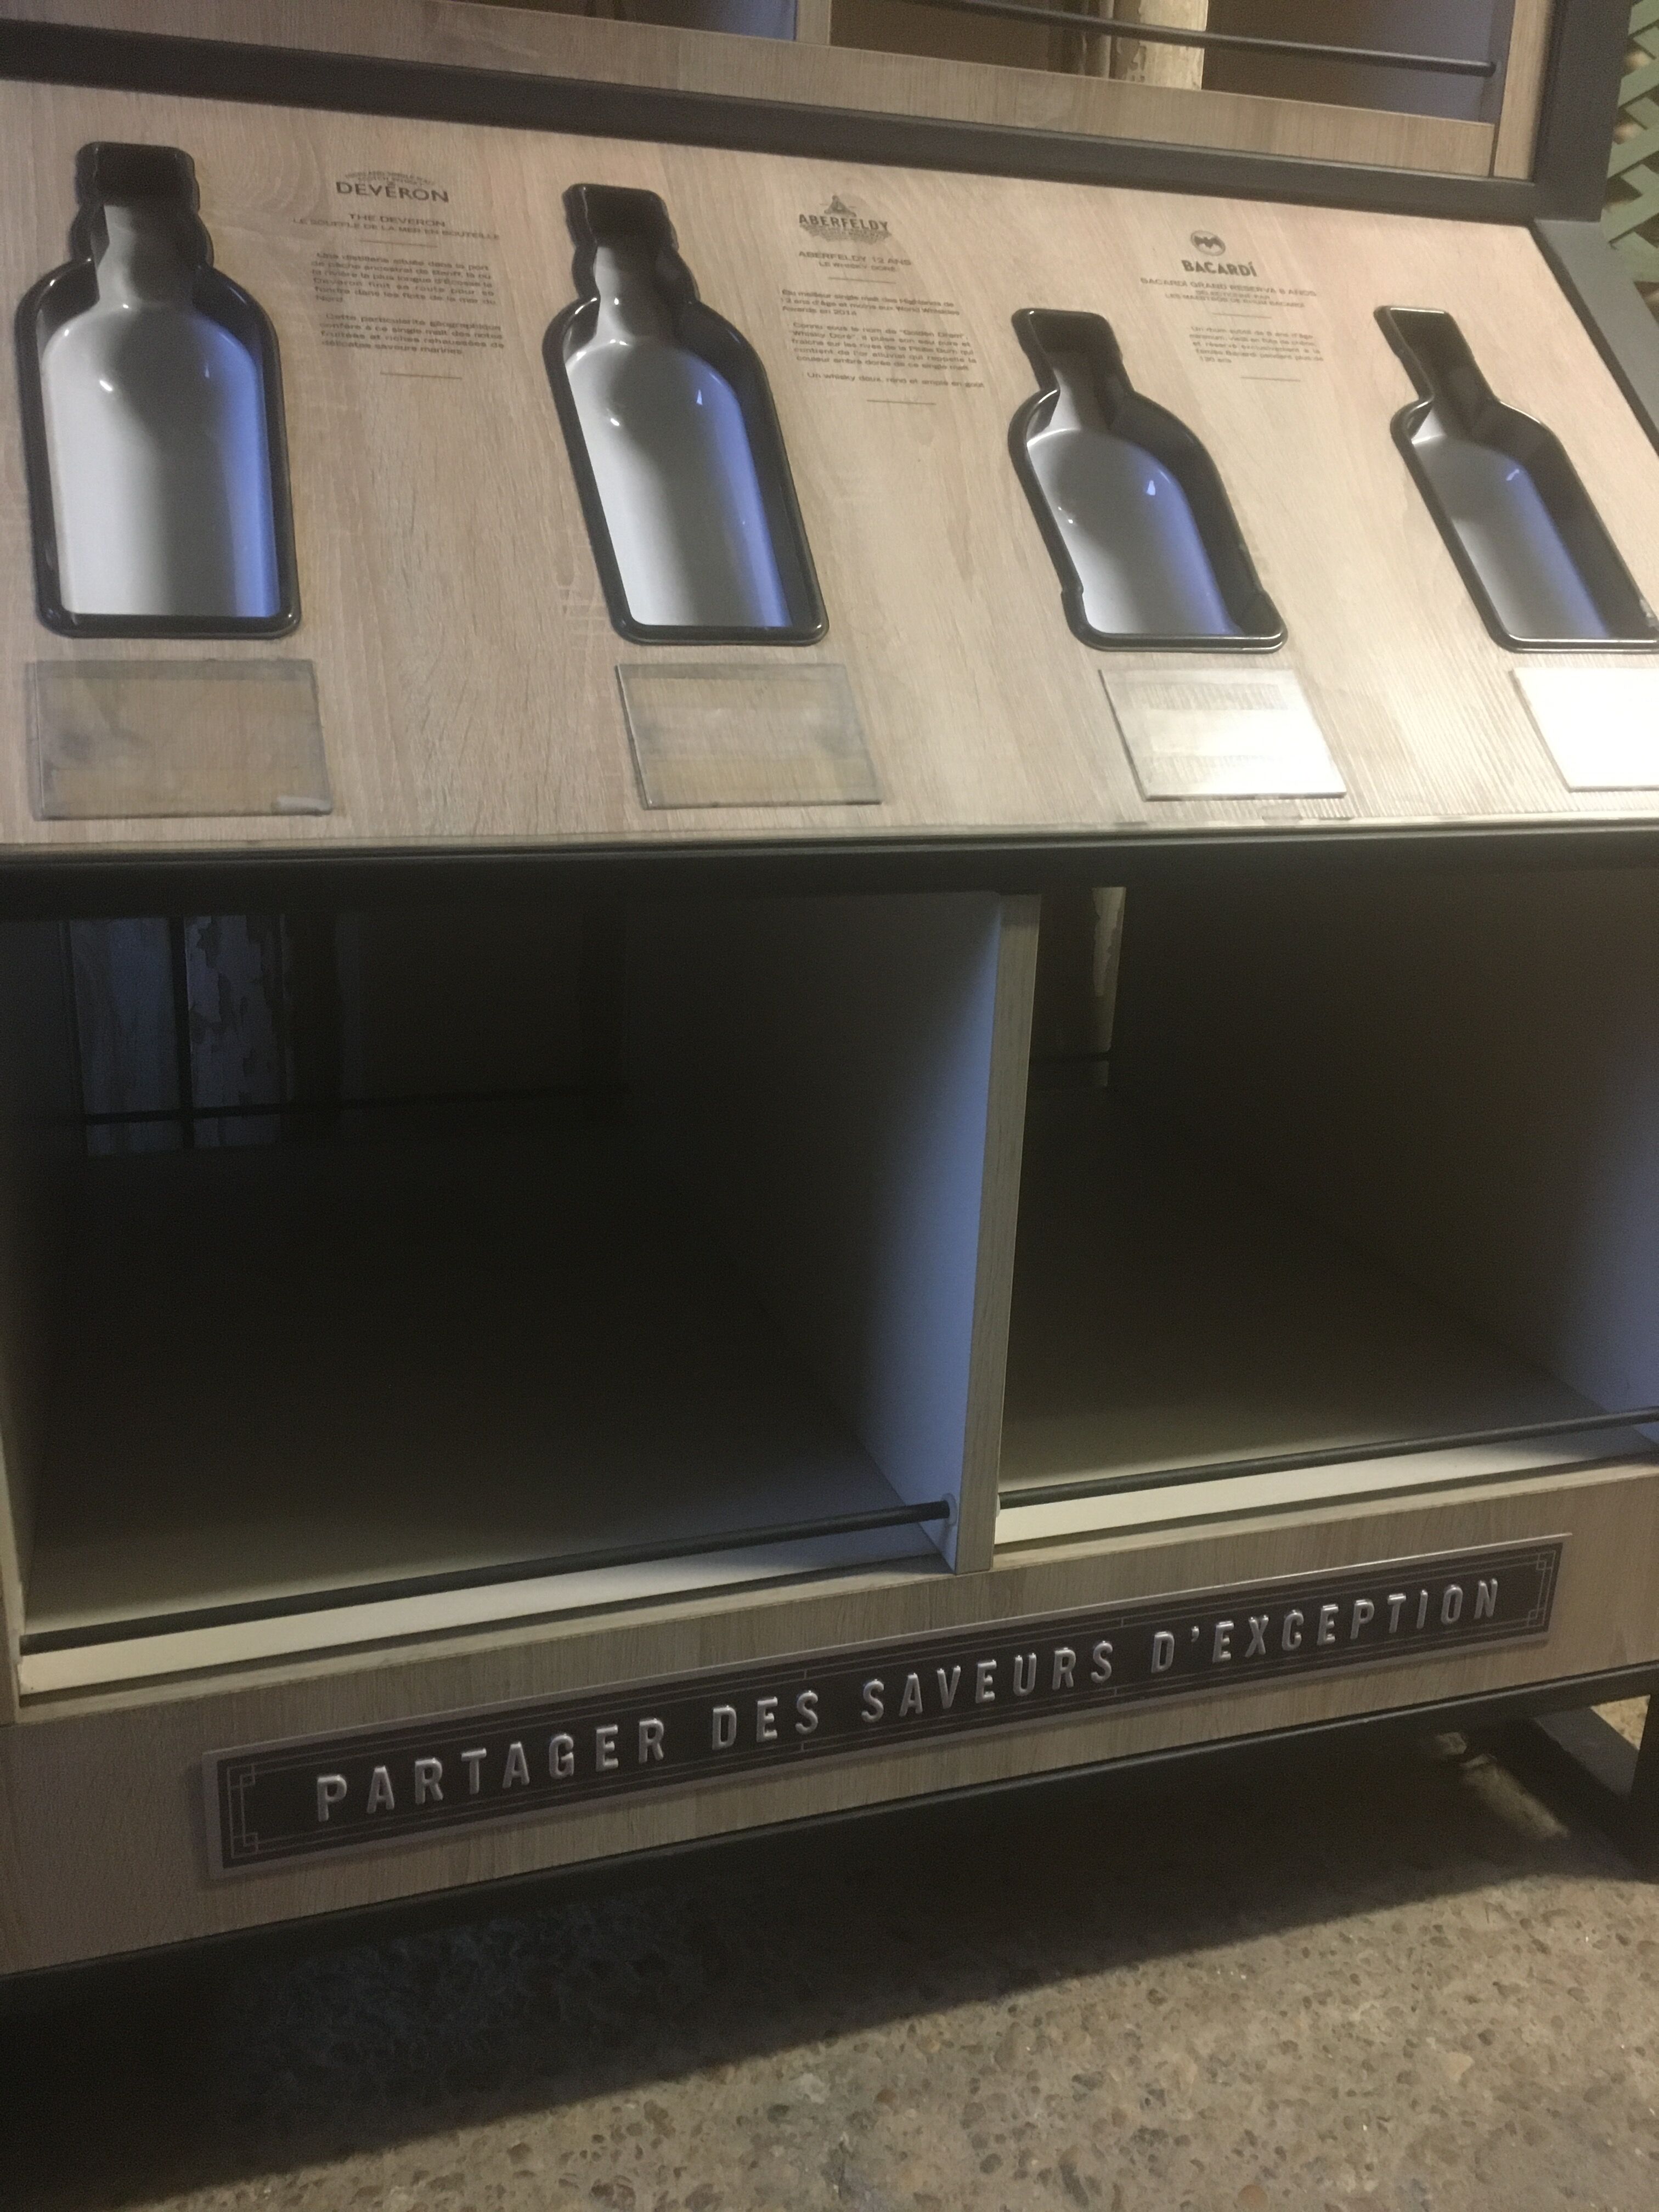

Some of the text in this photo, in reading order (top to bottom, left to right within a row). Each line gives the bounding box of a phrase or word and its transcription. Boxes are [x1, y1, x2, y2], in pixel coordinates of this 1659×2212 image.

[349, 213, 445, 227] THE DEVERON
[799, 214, 888, 231] ABERFELDY
[798, 251, 912, 266] ABERFELDY 12 ANS
[1181, 260, 1257, 277] BACARDÍ
[317, 1577, 1499, 1822] PARTAGER DES SAVEURS D'EXCEPTION
